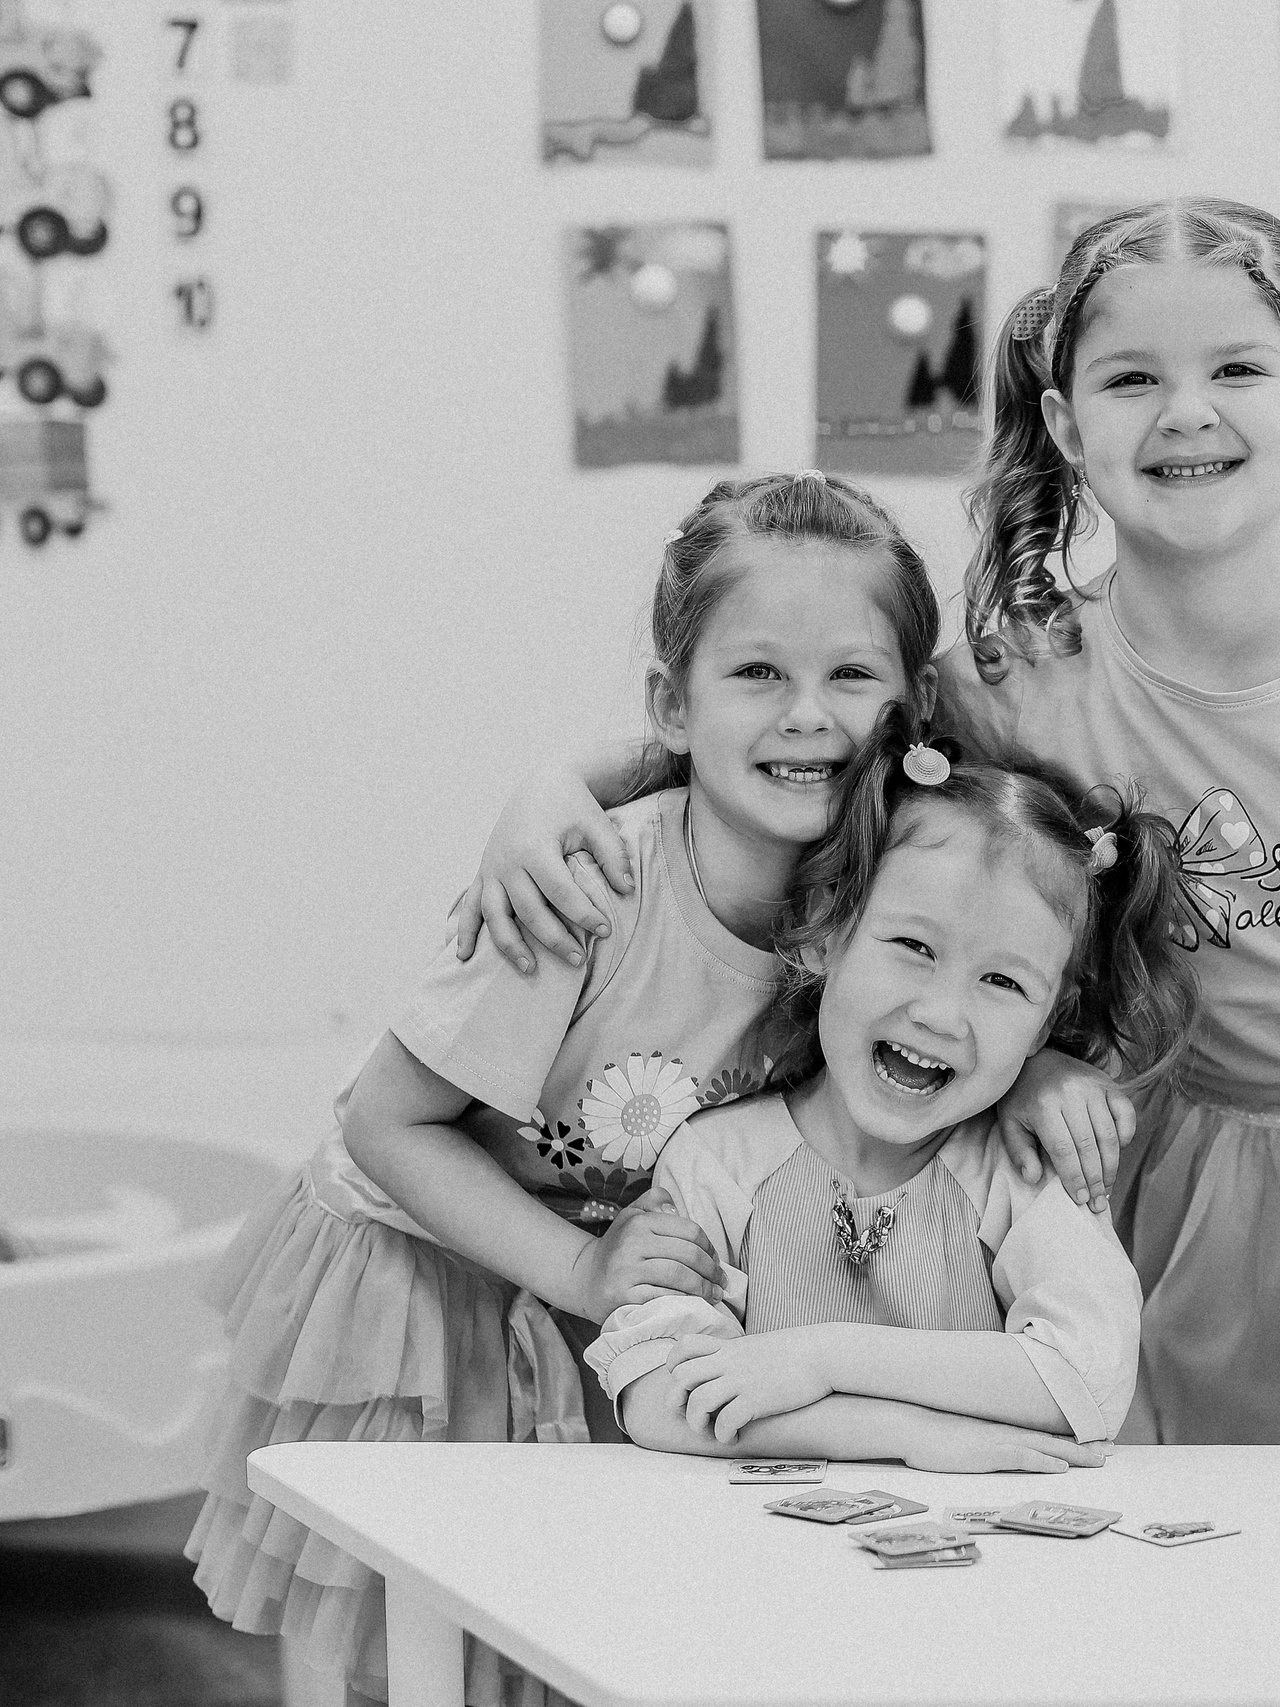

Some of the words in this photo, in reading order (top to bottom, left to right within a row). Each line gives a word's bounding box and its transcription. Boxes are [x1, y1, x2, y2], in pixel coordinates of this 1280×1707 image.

[168, 18, 199, 70] 7
[169, 99, 200, 151] 8
[170, 186, 203, 239] 9
[173, 279, 216, 331] 10
